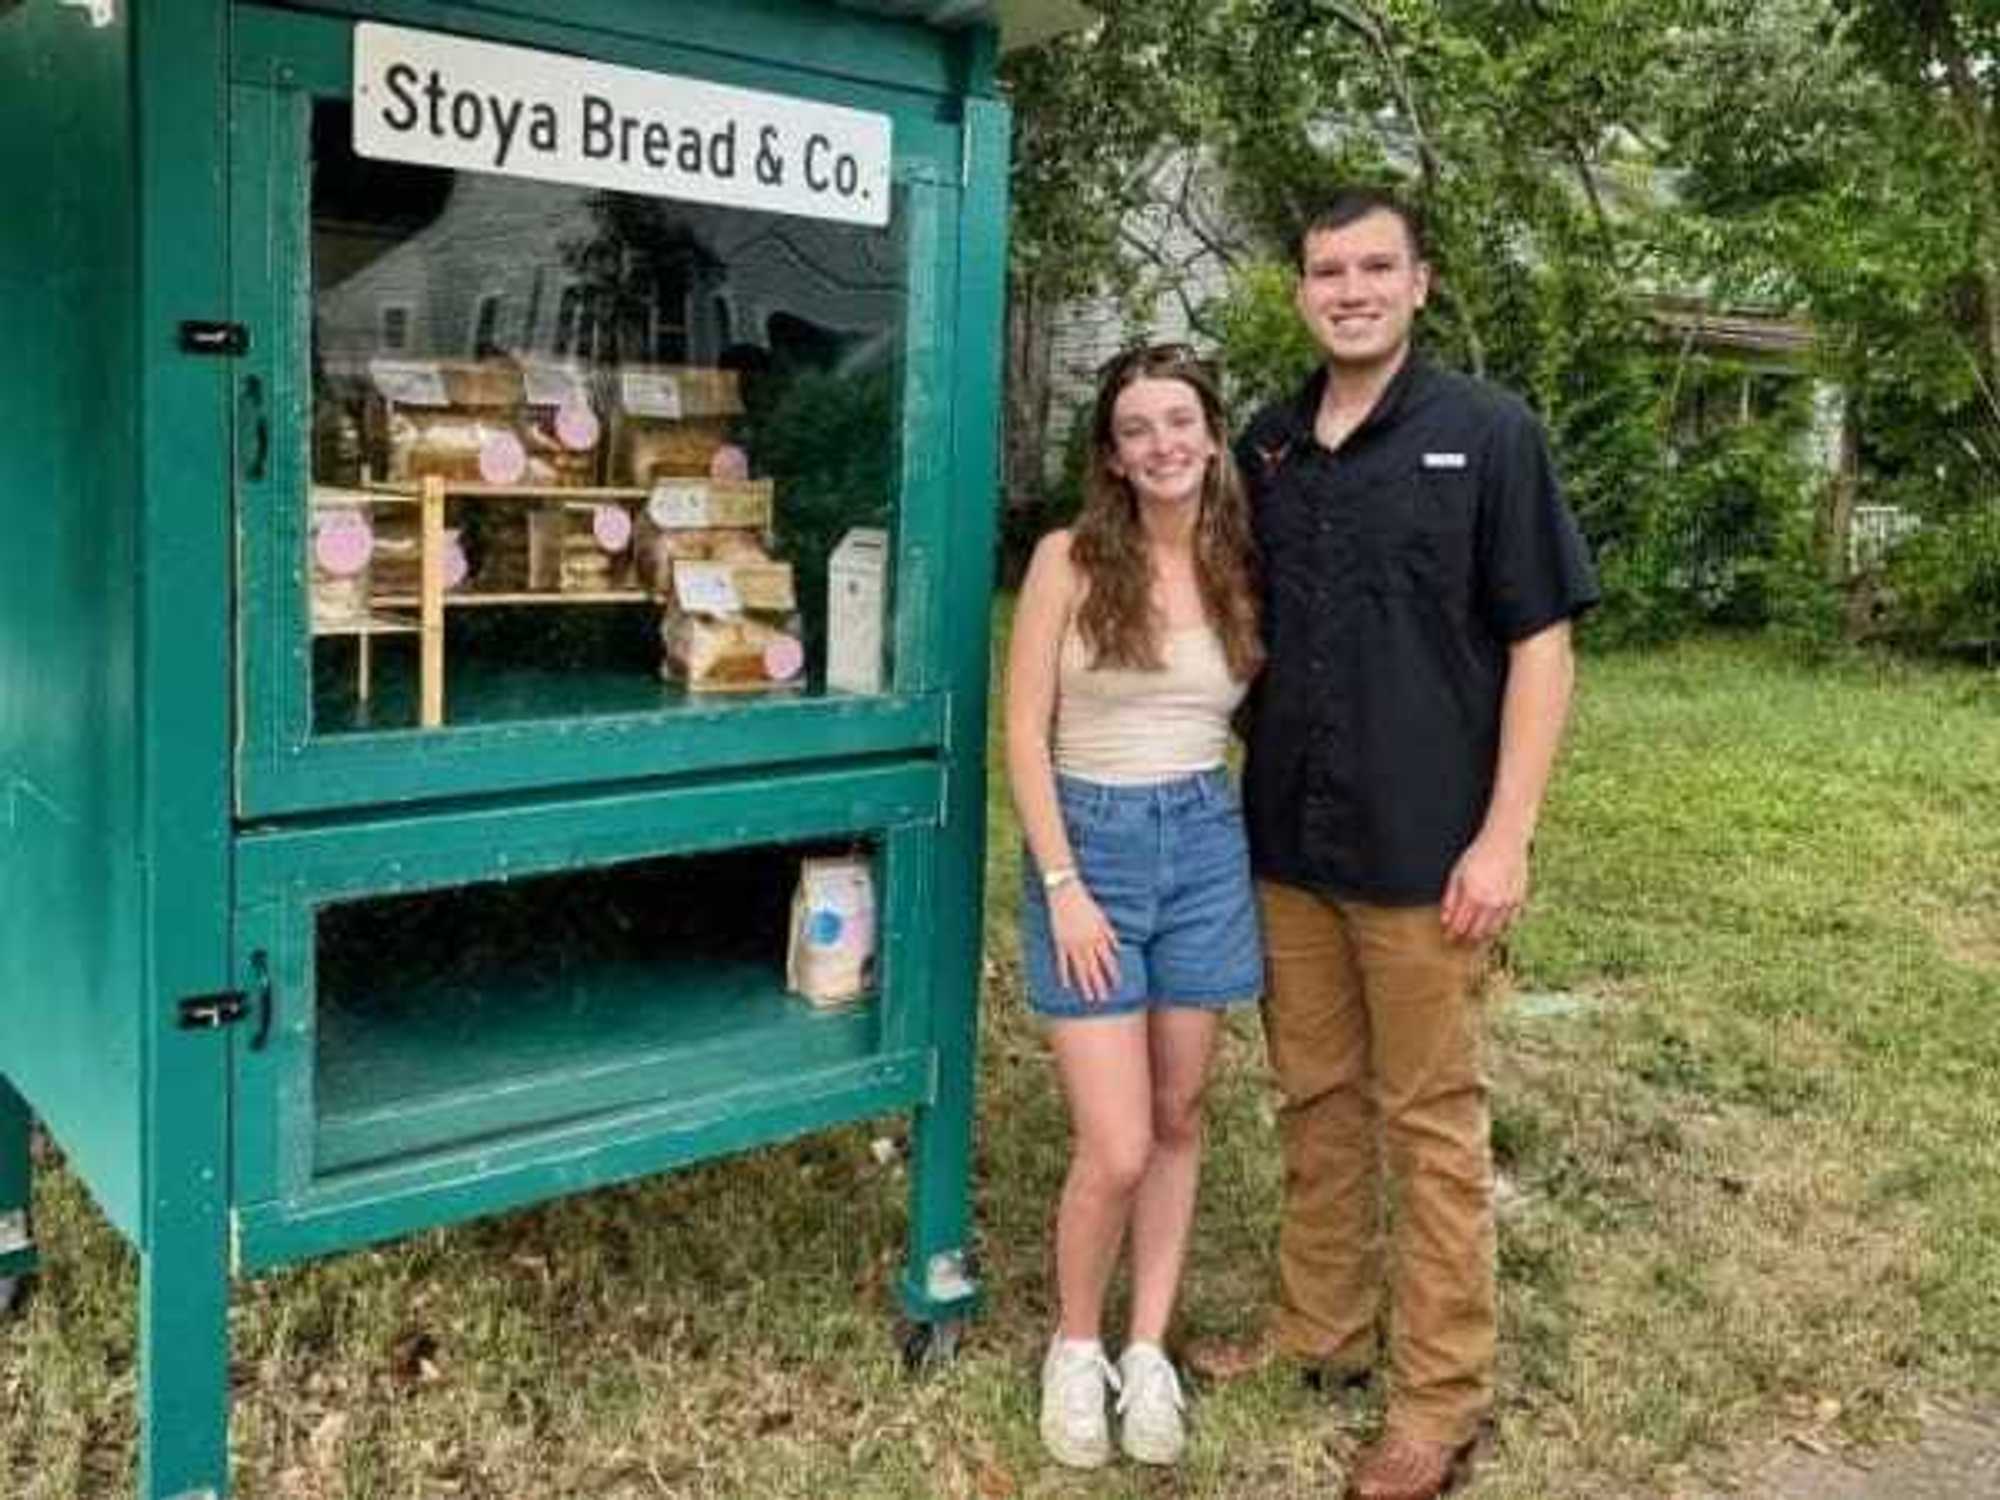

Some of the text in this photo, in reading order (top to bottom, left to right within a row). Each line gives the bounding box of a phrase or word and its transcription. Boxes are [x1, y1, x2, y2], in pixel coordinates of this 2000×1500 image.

[382, 63, 870, 200] Stoya Bread & Co.
